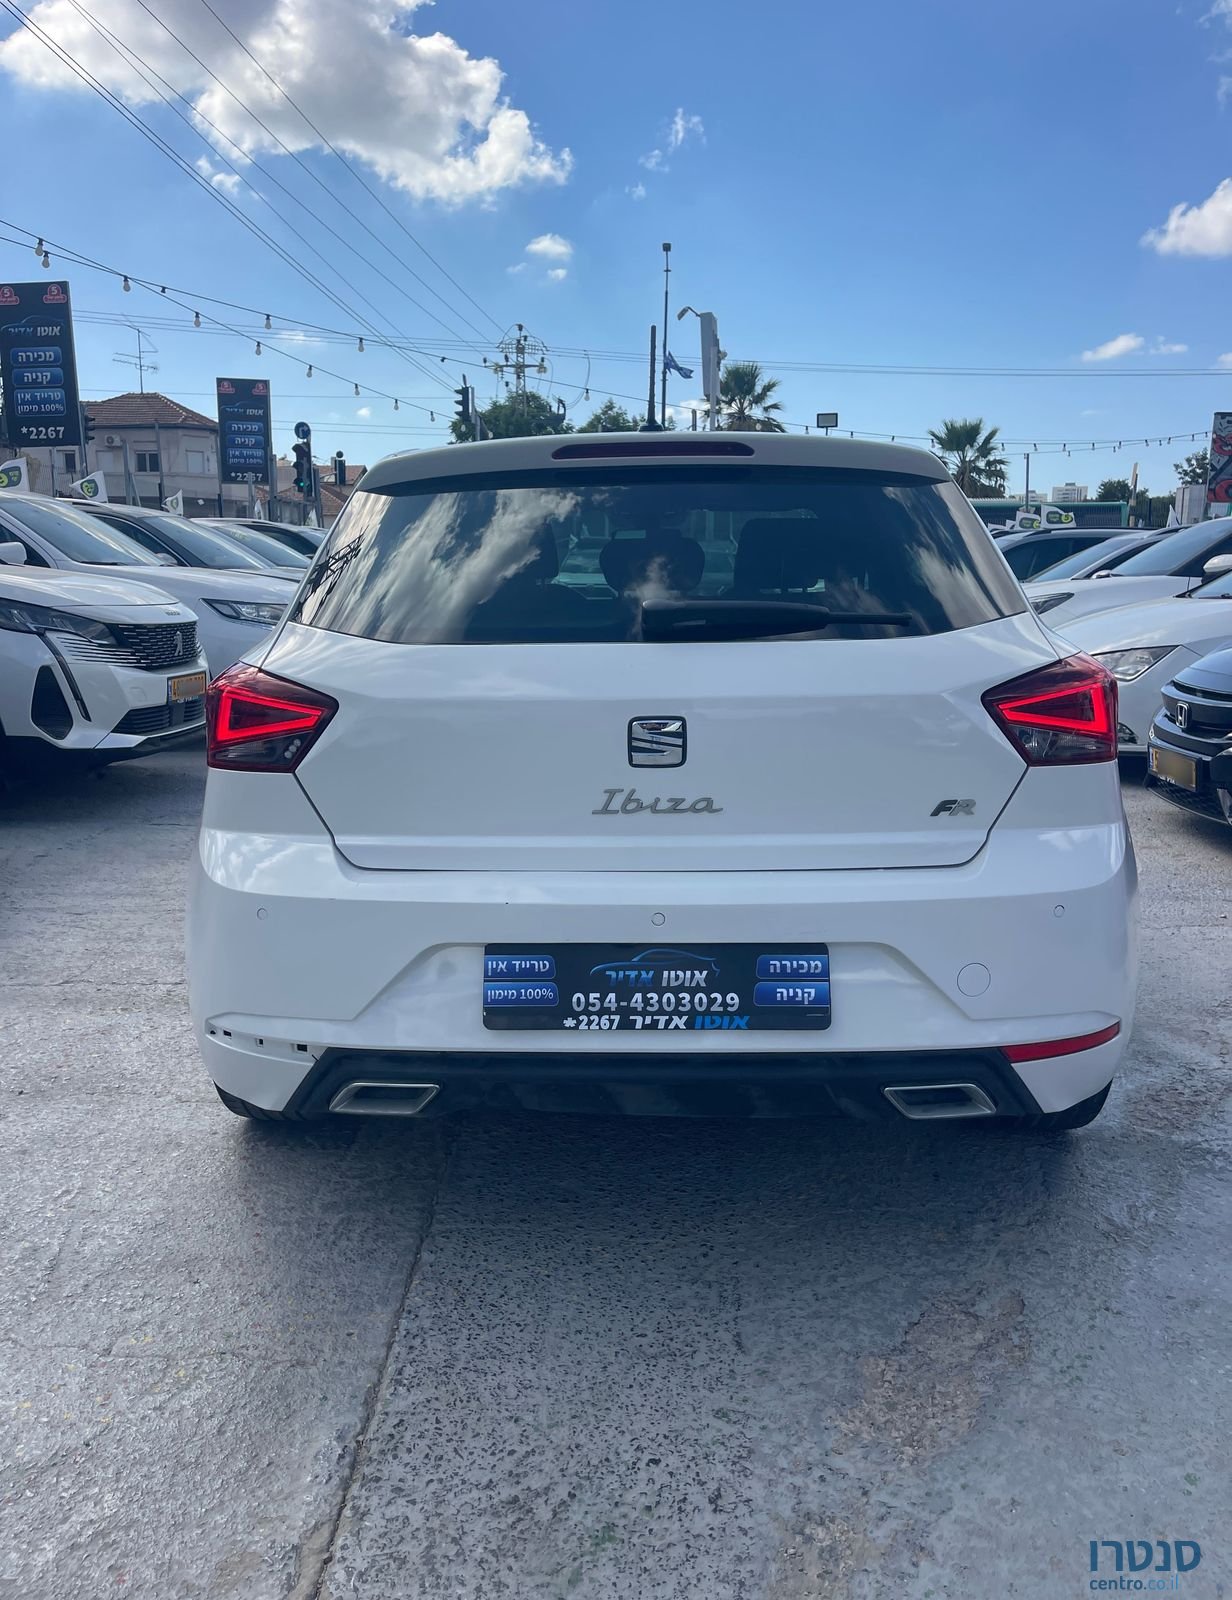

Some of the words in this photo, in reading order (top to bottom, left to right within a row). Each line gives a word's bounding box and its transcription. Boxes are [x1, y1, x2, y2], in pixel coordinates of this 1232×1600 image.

[36, 326, 61, 337] אוטו
[18, 351, 55, 363] מכירה
[23, 372, 51, 384] קניה
[17, 392, 31, 403] אין
[35, 392, 61, 402] טרייד
[18, 404, 39, 414] מימון
[41, 403, 64, 412] 100%
[231, 424, 259, 432] מכירה
[234, 437, 256, 447] קניה
[592, 788, 723, 815] Ibiza
[930, 799, 977, 817] FR
[487, 960, 507, 976] אין
[512, 960, 550, 973] טרייד
[769, 959, 822, 974] מכירה
[605, 970, 655, 987] אדיר
[661, 970, 708, 987] אוטו
[487, 989, 517, 1002] מימון
[519, 988, 554, 1000] 100%
[775, 987, 817, 1005] קניה
[571, 992, 740, 1012] 054-4303029
[627, 1015, 688, 1030] אדיר
[694, 1015, 750, 1030] אוטו
